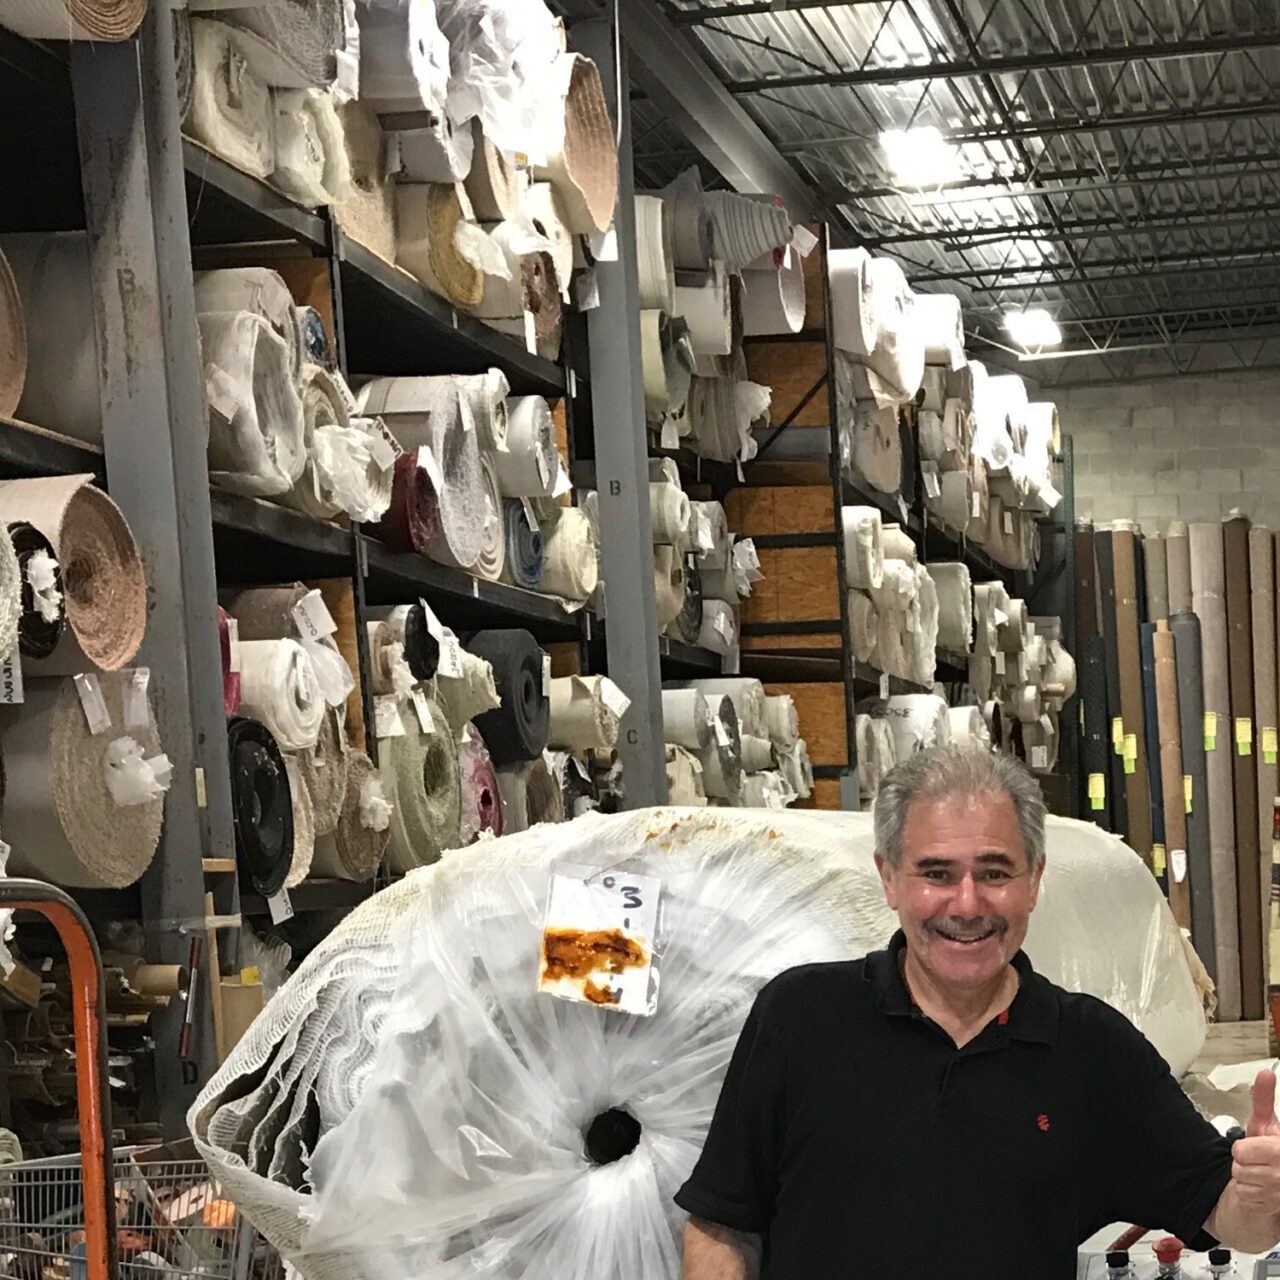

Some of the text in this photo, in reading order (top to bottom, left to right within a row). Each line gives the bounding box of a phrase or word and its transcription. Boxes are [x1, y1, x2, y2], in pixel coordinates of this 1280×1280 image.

[610, 480, 621, 496] B
[627, 729, 638, 745] C
[182, 1061, 198, 1085] D
